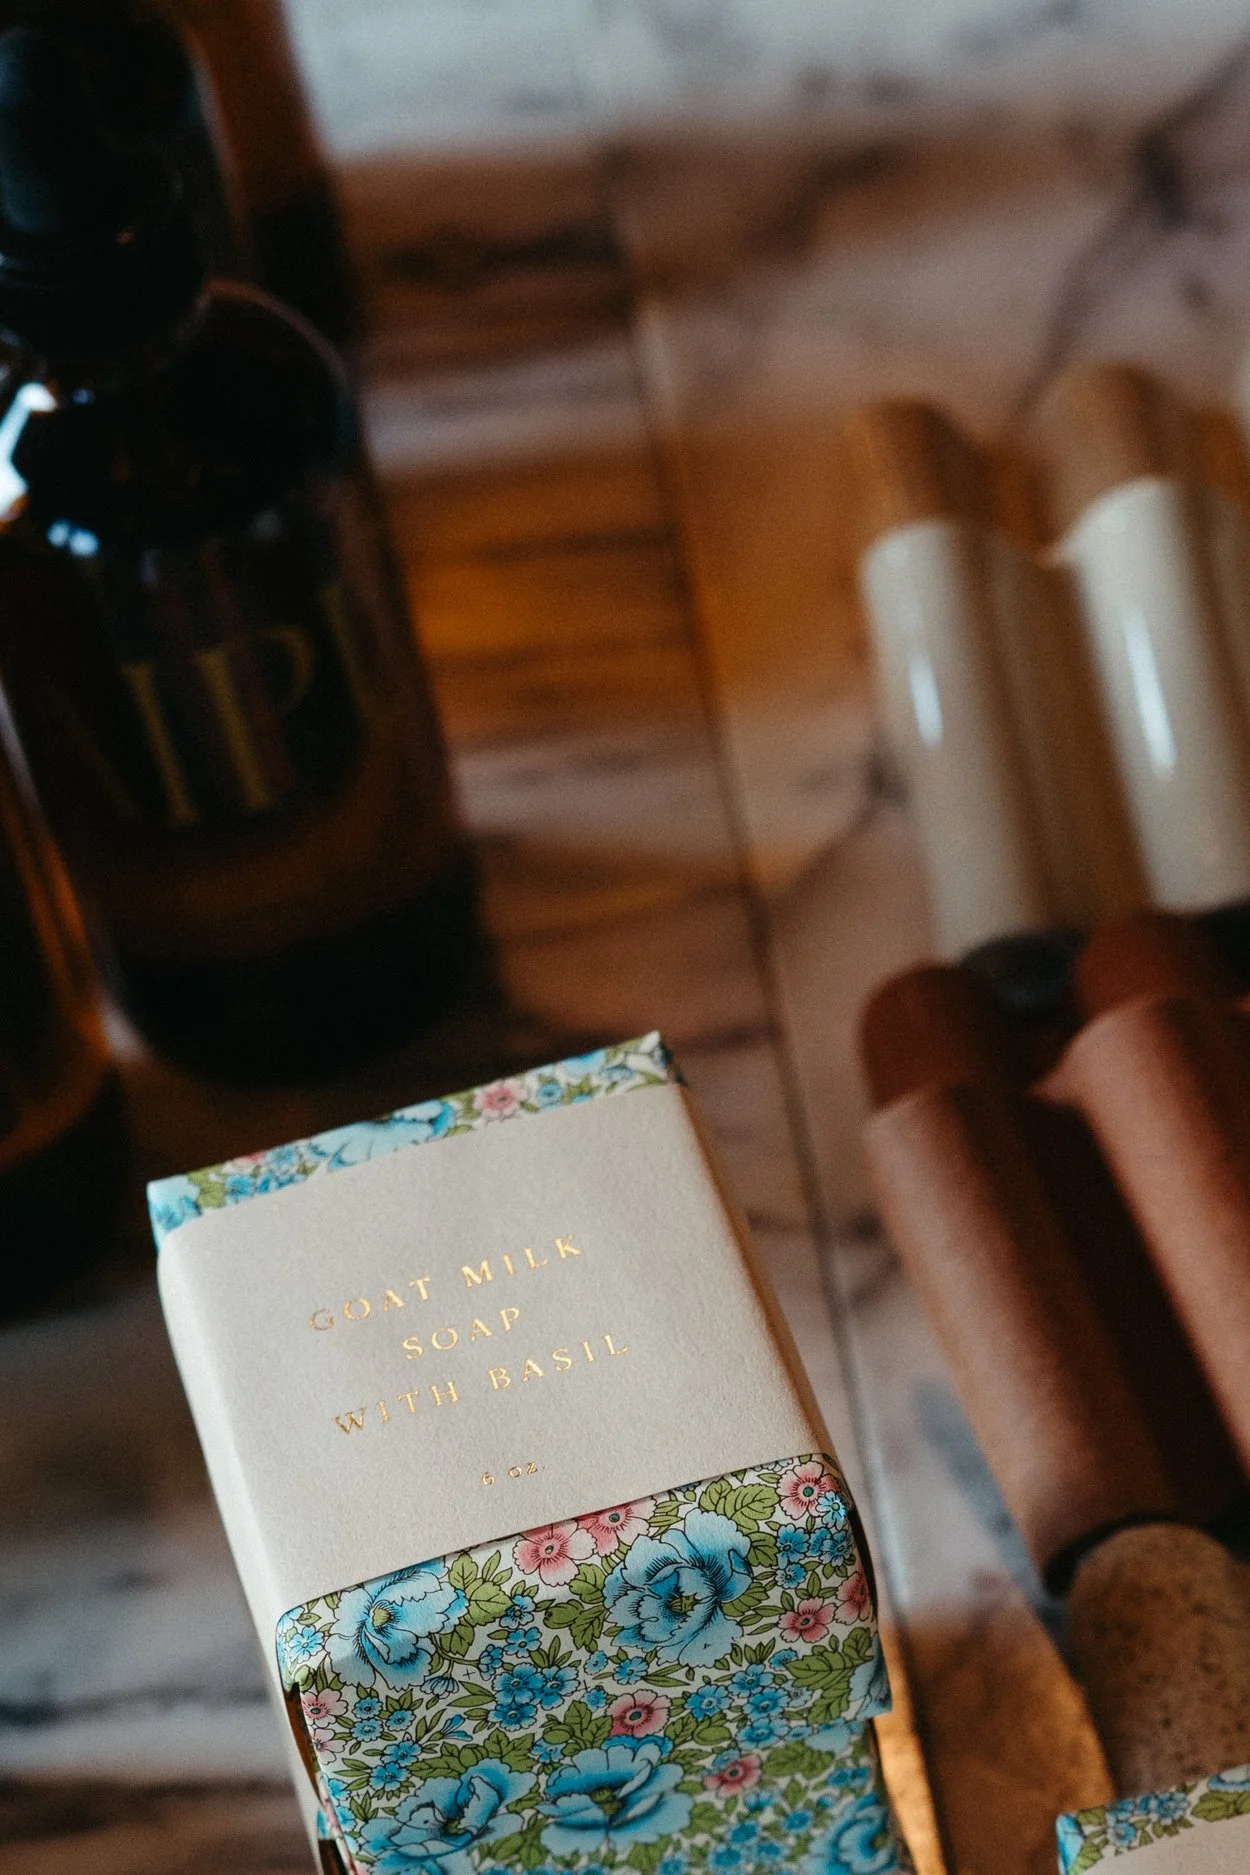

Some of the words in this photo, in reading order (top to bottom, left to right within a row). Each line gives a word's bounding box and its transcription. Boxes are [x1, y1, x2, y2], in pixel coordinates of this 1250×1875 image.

[309, 1276, 431, 1331] GOAT
[461, 1235, 581, 1288] MILK
[402, 1307, 520, 1359] SOAP
[333, 1381, 459, 1435] WITH
[488, 1333, 628, 1390] BASIL
